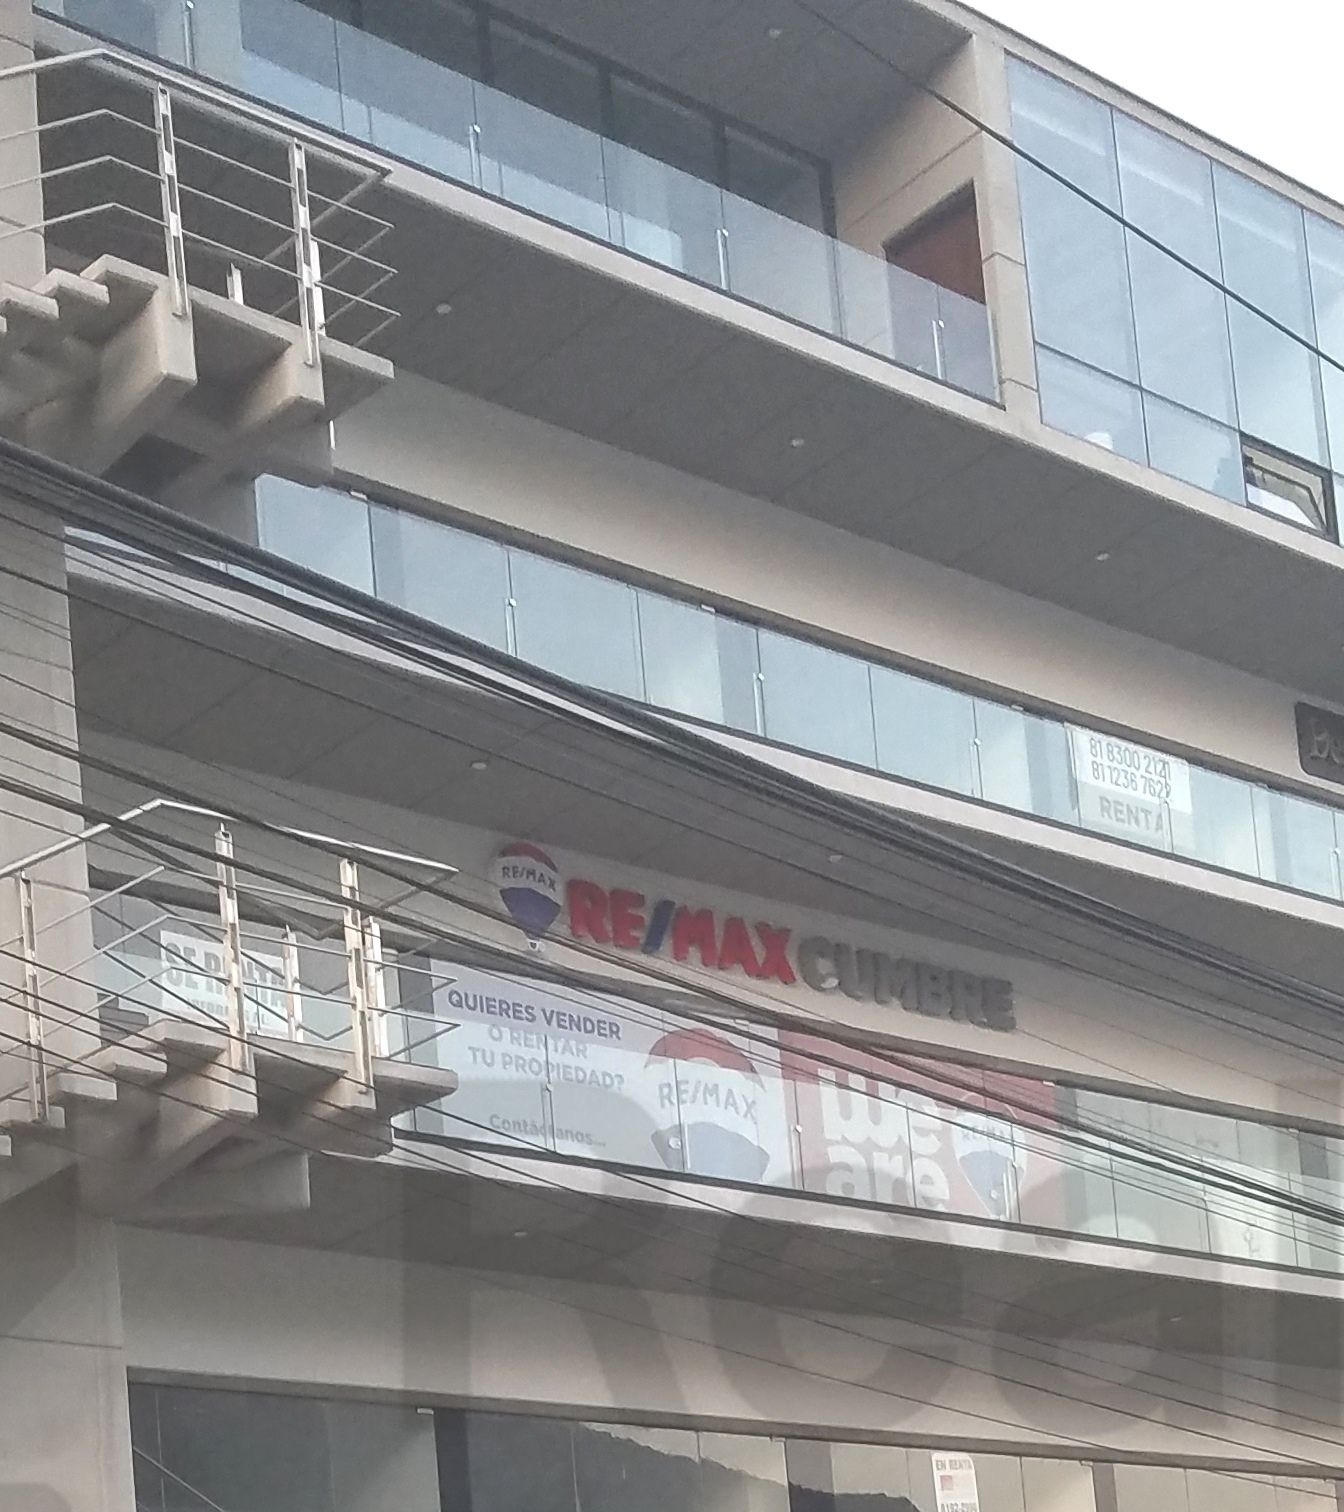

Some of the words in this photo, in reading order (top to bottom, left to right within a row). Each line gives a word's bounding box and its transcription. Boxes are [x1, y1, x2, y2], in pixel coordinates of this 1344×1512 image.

[1106, 742, 1140, 770] 8300
[502, 865, 557, 893] RE/MAX
[565, 878, 797, 986] RE/MAX
[797, 935, 1017, 1033] CUMBRE
[448, 989, 537, 1023] QUIERES
[541, 1007, 622, 1041] VENDER
[509, 1028, 588, 1059] RENTAR
[467, 1046, 495, 1068] TU
[501, 1053, 625, 1092] PROPIEDAD?
[658, 1079, 757, 1121] RE/MAX
[825, 1143, 951, 1213] are
